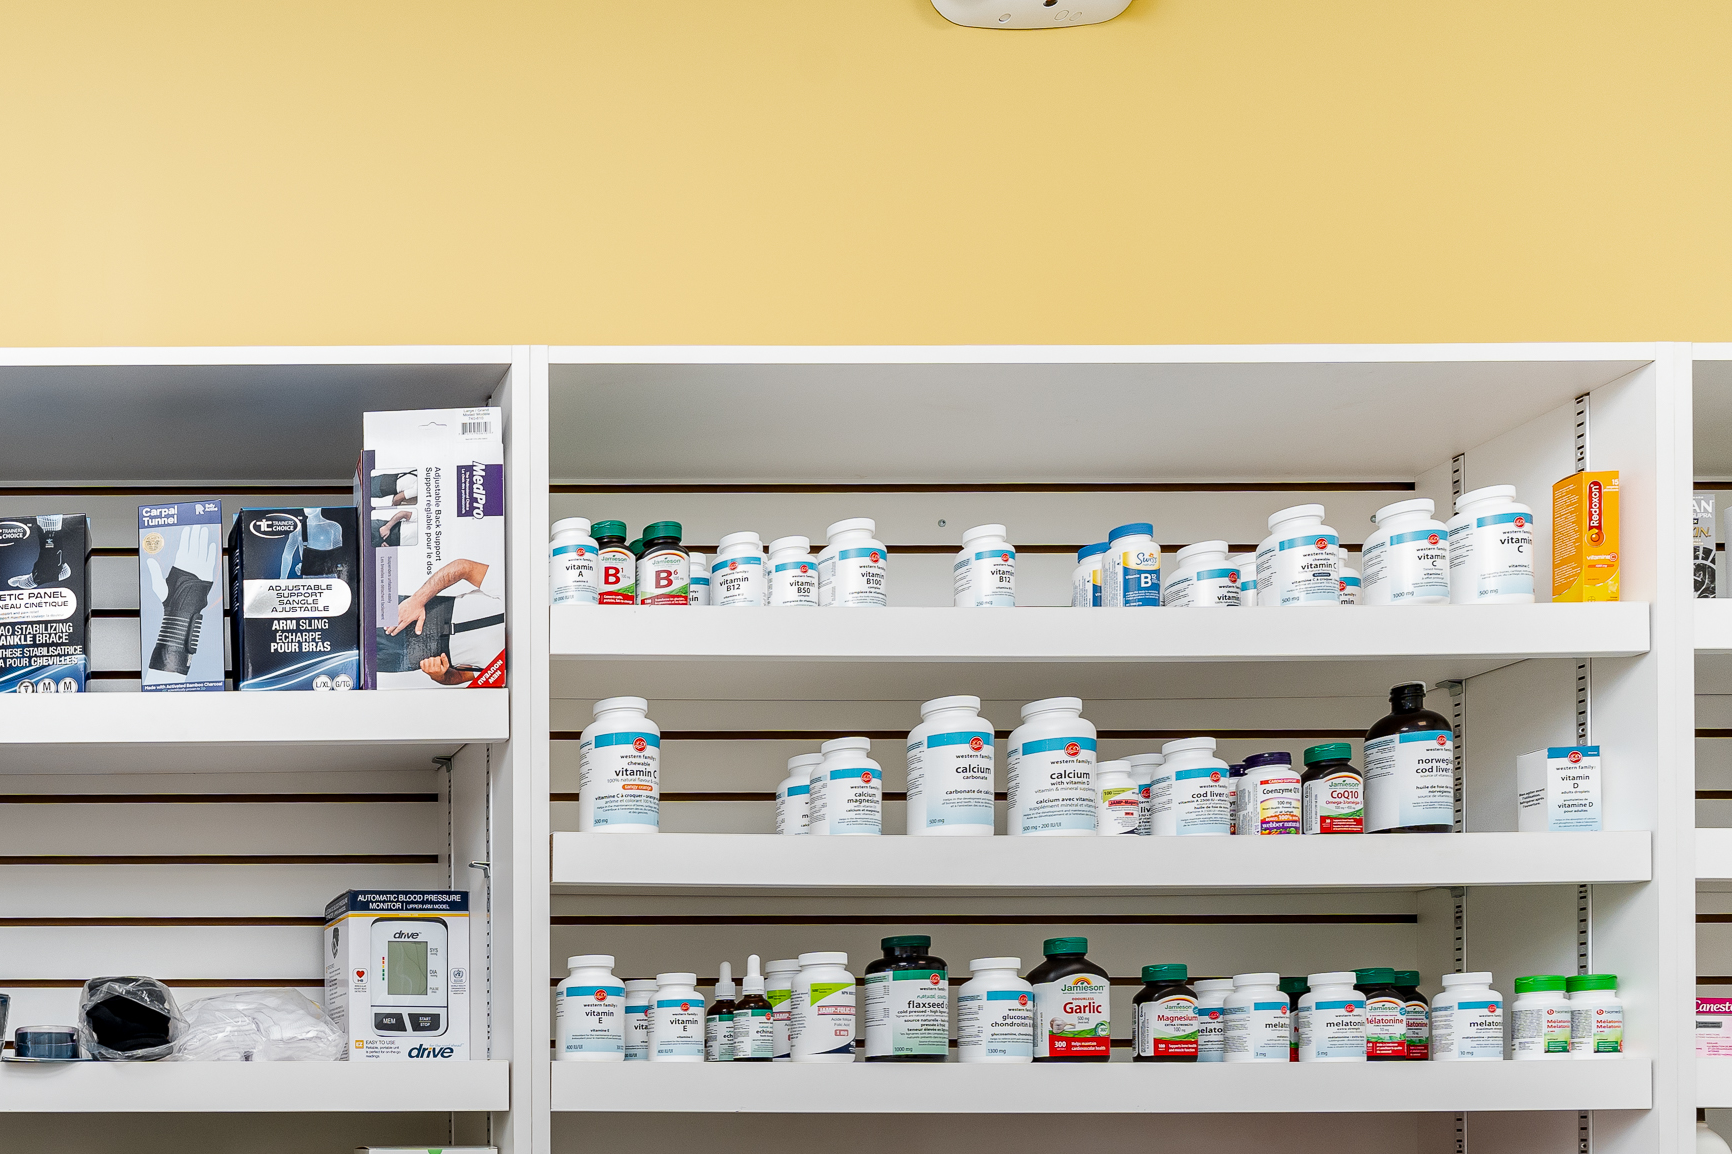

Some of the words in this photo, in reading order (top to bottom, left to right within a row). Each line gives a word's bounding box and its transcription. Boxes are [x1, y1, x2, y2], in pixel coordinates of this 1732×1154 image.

[470, 461, 484, 519] MedPro
[142, 507, 177, 518] Carpal
[1590, 486, 1600, 529] Redoxon
[142, 516, 177, 525] Tunnel
[720, 576, 749, 586] vitamin
[955, 764, 991, 774] calcium
[1331, 790, 1359, 801] CoQ10
[357, 894, 397, 902] AUTOMATIC
[398, 894, 423, 902] BLOOD
[424, 894, 461, 902] PRESSURE
[1060, 983, 1104, 992] Jamieson
[1063, 1001, 1101, 1016] Garlic
[408, 1044, 454, 1060] drive
